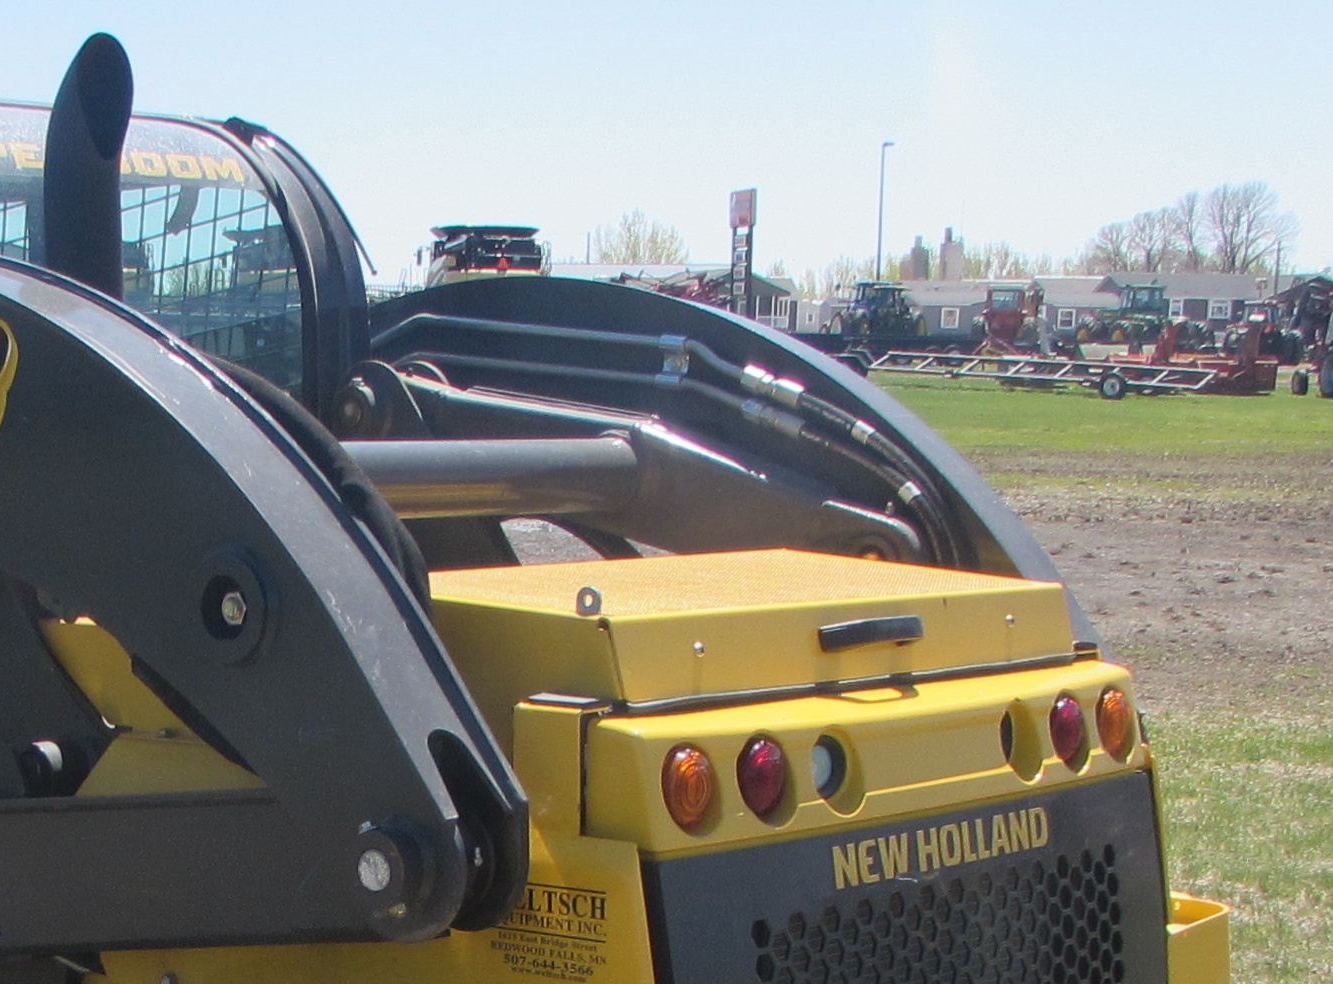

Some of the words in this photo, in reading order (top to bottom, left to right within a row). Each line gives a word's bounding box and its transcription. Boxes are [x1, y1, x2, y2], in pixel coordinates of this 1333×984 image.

[831, 832, 909, 890] NEW
[916, 806, 1050, 872] HOLLAND
[516, 887, 606, 920] LTSCH
[578, 920, 607, 937] INC.
[490, 940, 545, 956] REDWOOD
[589, 954, 606, 965] MN
[540, 937, 569, 949] Bridge
[571, 941, 597, 952] Street
[504, 953, 594, 976] 507-644-3566
